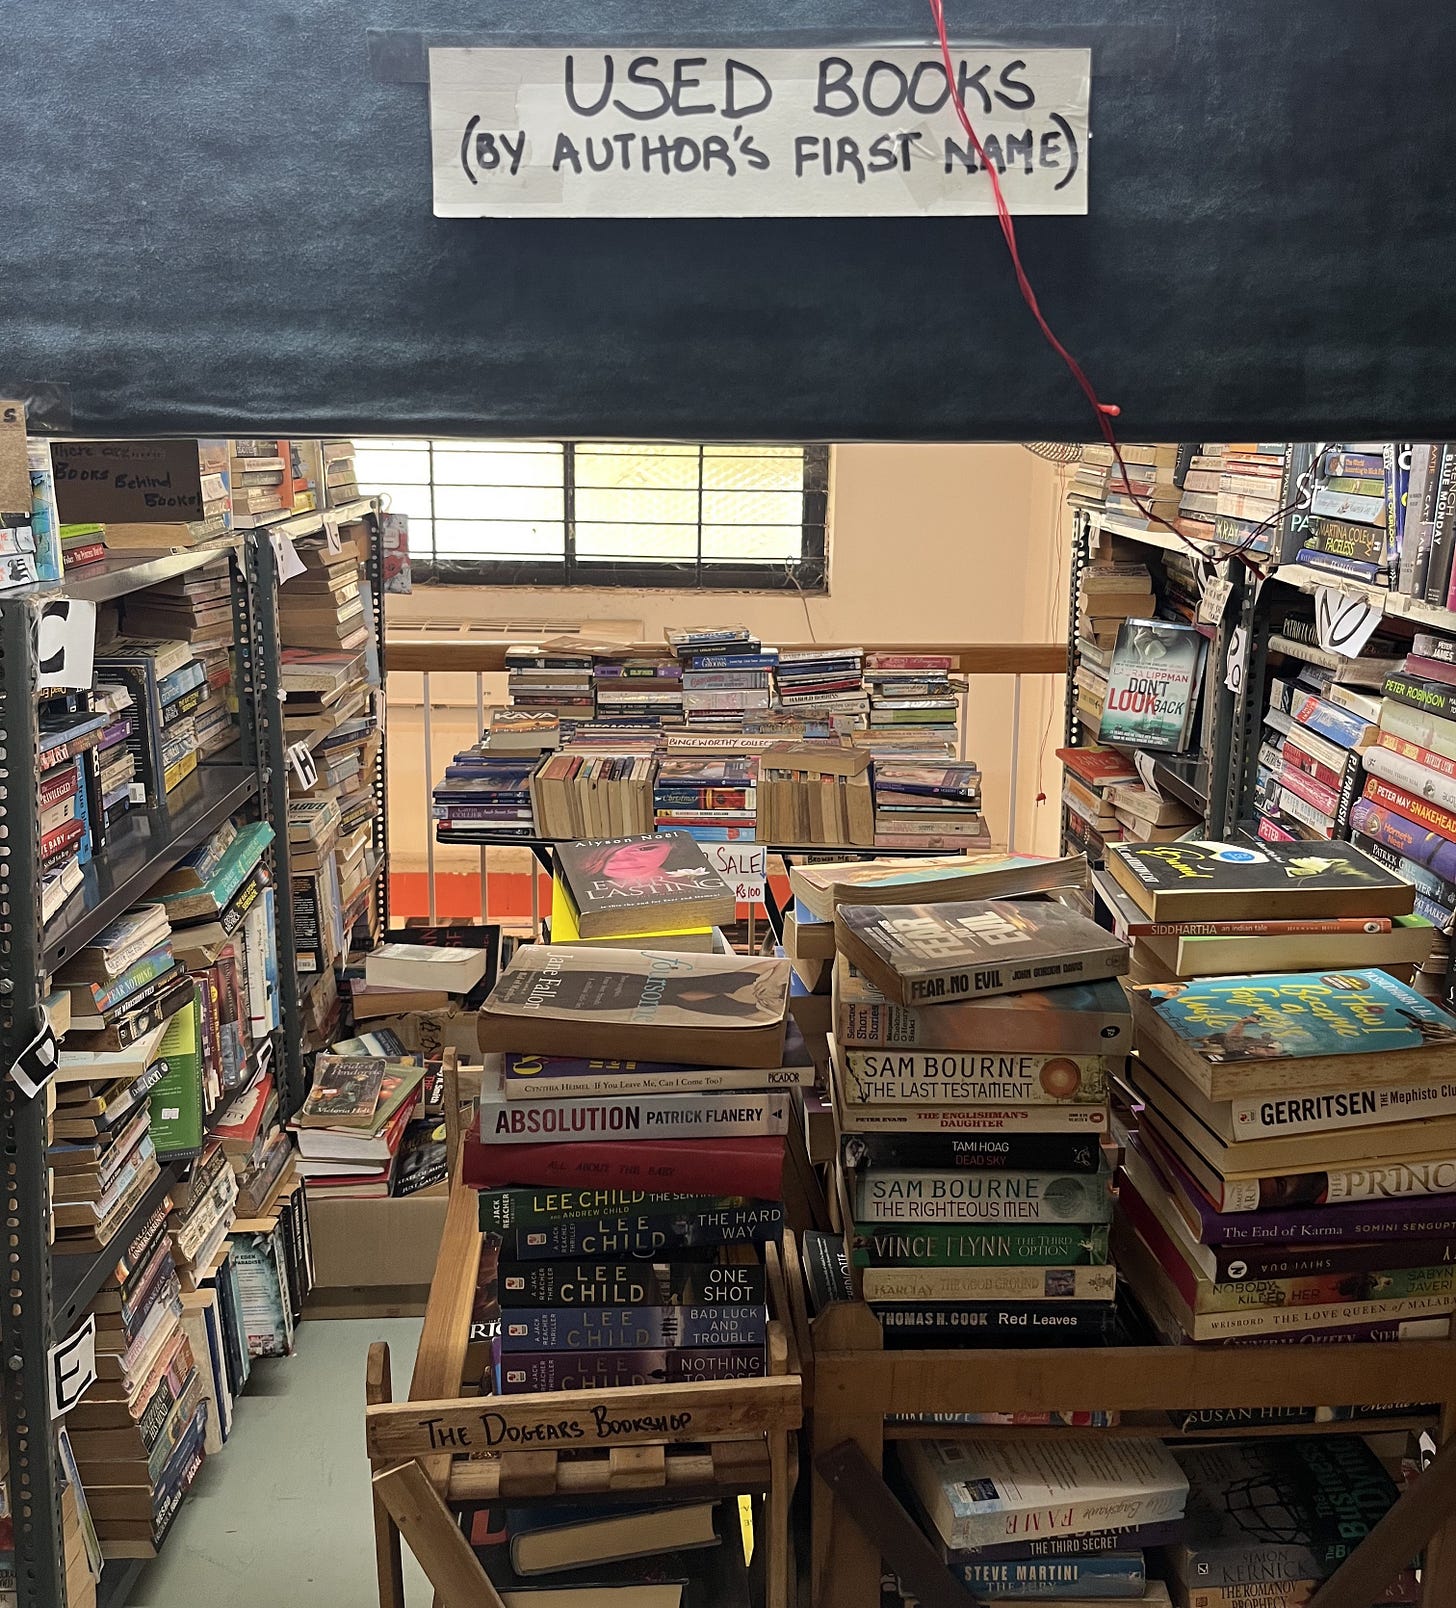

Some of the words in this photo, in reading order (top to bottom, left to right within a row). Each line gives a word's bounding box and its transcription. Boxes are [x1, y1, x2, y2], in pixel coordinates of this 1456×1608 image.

[565, 54, 773, 119] USED
[813, 55, 1036, 116] BOOKS
[461, 115, 525, 184] (BY
[552, 125, 770, 177] AUTHOR'S
[795, 132, 922, 184] FIRST
[943, 112, 1079, 191] NAME)
[55, 463, 110, 481] Books
[115, 473, 172, 489] Behind
[1433, 491, 1449, 546] MONDAY
[1128, 677, 1170, 697] DON'T
[1146, 672, 1189, 683] LIPPMAN
[1107, 687, 1159, 716] LOOK
[1385, 679, 1406, 695] PETER
[1406, 686, 1446, 708] ROBINSON
[1153, 699, 1186, 715] BACK
[1336, 778, 1355, 827] PARRISH
[1376, 785, 1397, 803] PETER
[1395, 795, 1412, 809] MAY
[1410, 801, 1456, 834] SNAKEHEAD
[575, 836, 633, 848] Alyson
[641, 830, 680, 843] Noël
[716, 845, 762, 875] SALE
[585, 878, 725, 901] LASTING
[1151, 923, 1218, 937] SIDDHARTHA
[542, 951, 574, 986] Jane
[523, 978, 563, 1010] Fallon
[911, 981, 946, 999] FEAR
[950, 977, 970, 994] NO
[974, 970, 1003, 989] EVIL
[1011, 970, 1032, 981] JOHN
[857, 1010, 868, 1040] Short
[864, 1056, 915, 1079] SAM
[923, 1056, 1034, 1079] BOURNE
[524, 1083, 559, 1093] CYNTHIA
[560, 1080, 591, 1092] HEIMEL
[594, 1079, 602, 1089] If
[602, 1079, 618, 1089] You
[619, 1078, 641, 1089] Leave
[642, 1077, 657, 1090] Me,
[658, 1077, 675, 1088] Can
[680, 1076, 704, 1087] Come
[704, 1075, 723, 1086] Too?
[767, 1072, 801, 1084] PICADOR
[864, 1081, 897, 1099] THE
[900, 1082, 948, 1099] LAST
[948, 1081, 1034, 1099] TESTAMENT
[917, 1112, 942, 1121] THE
[945, 1110, 1030, 1121] ENGLISHMAN'S
[1260, 1091, 1377, 1127] GERRITSEN
[1380, 1092, 1389, 1108] THE
[1389, 1088, 1439, 1105] Mephisto
[495, 1105, 641, 1134] ABSOLUTION
[646, 1110, 702, 1127] PATRICK
[706, 1107, 764, 1123] FLANERY
[939, 1119, 1005, 1129] DAUGHTER
[952, 1141, 977, 1153] TAMI
[979, 1140, 1010, 1153] HOAG
[955, 1154, 984, 1166] DEAD
[986, 1154, 1008, 1166] SKY
[872, 1180, 925, 1199] SAM
[931, 1179, 1041, 1199] BOURNE
[532, 1193, 573, 1212] LEE
[578, 1188, 646, 1209] CHILD
[872, 1201, 906, 1218] THE
[908, 1200, 1001, 1218] RIGHTEOUS
[1003, 1201, 1041, 1218] MEN
[502, 1193, 511, 1229] REACHER
[562, 1209, 601, 1219] ANDREW
[603, 1206, 630, 1216] CHILD
[598, 1215, 650, 1233] LEE
[697, 1213, 732, 1227] THE
[736, 1208, 782, 1226] HARD
[582, 1231, 666, 1254] CHILD
[721, 1226, 757, 1240] WAY
[1223, 1227, 1248, 1239] The
[1251, 1226, 1278, 1238] End
[1281, 1225, 1298, 1237] of
[1300, 1224, 1344, 1236] Karma
[1354, 1223, 1400, 1234] SOMINI
[873, 1235, 937, 1258] VINCE
[946, 1234, 1012, 1257] FLYNN
[1016, 1237, 1036, 1246] THE
[1037, 1236, 1074, 1246] THIRD
[1017, 1245, 1069, 1257] OPTION
[576, 1266, 628, 1282] LEE
[708, 1269, 749, 1284] ONE
[1261, 1261, 1288, 1272] DUA
[1294, 1259, 1333, 1270] SHIVI
[560, 1284, 645, 1303] CHILD
[703, 1286, 755, 1302] SHOT
[993, 1277, 1040, 1291] GROUND
[1213, 1281, 1276, 1296] NOBODY
[1237, 1291, 1287, 1305] KILLED
[1291, 1288, 1321, 1302] HER
[1406, 1279, 1454, 1292] JAVERI
[582, 1311, 633, 1328] LEE
[690, 1309, 718, 1320] BAD
[721, 1307, 759, 1320] LUCK
[878, 1312, 936, 1327] THOMAS
[936, 1313, 949, 1326] H.
[950, 1312, 989, 1326] COOK
[998, 1312, 1028, 1326] Red
[1032, 1313, 1078, 1327] Leaves
[1210, 1316, 1265, 1329] WEISBORD
[1273, 1312, 1301, 1325] THE
[1304, 1309, 1338, 1322] LOVE
[1342, 1304, 1386, 1318] QUEEN
[566, 1329, 650, 1349] CHILD
[709, 1319, 739, 1332] AND
[692, 1331, 756, 1344] TROUBLE
[54, 1320, 93, 1410] E
[577, 1358, 629, 1373] LEE
[680, 1357, 761, 1371] NOTHING
[1188, 1408, 1252, 1424] SUSAN
[1259, 1405, 1308, 1419] HILL
[419, 1418, 473, 1449] THE
[480, 1412, 585, 1446] DOGEARS
[590, 1405, 692, 1439] BOOKSHOP
[1006, 1507, 1075, 1536] FAME
[1029, 1540, 1048, 1555] THE
[1050, 1538, 1080, 1555] THIRD
[1081, 1536, 1118, 1553] SECRET
[1241, 1550, 1288, 1564] SIMON
[964, 1565, 1012, 1582] STEVE
[1015, 1565, 1079, 1582] MARTINI
[986, 1580, 1020, 1593] THE
[1220, 1586, 1245, 1600] THE
[1245, 1581, 1297, 1598] ROMANOV
